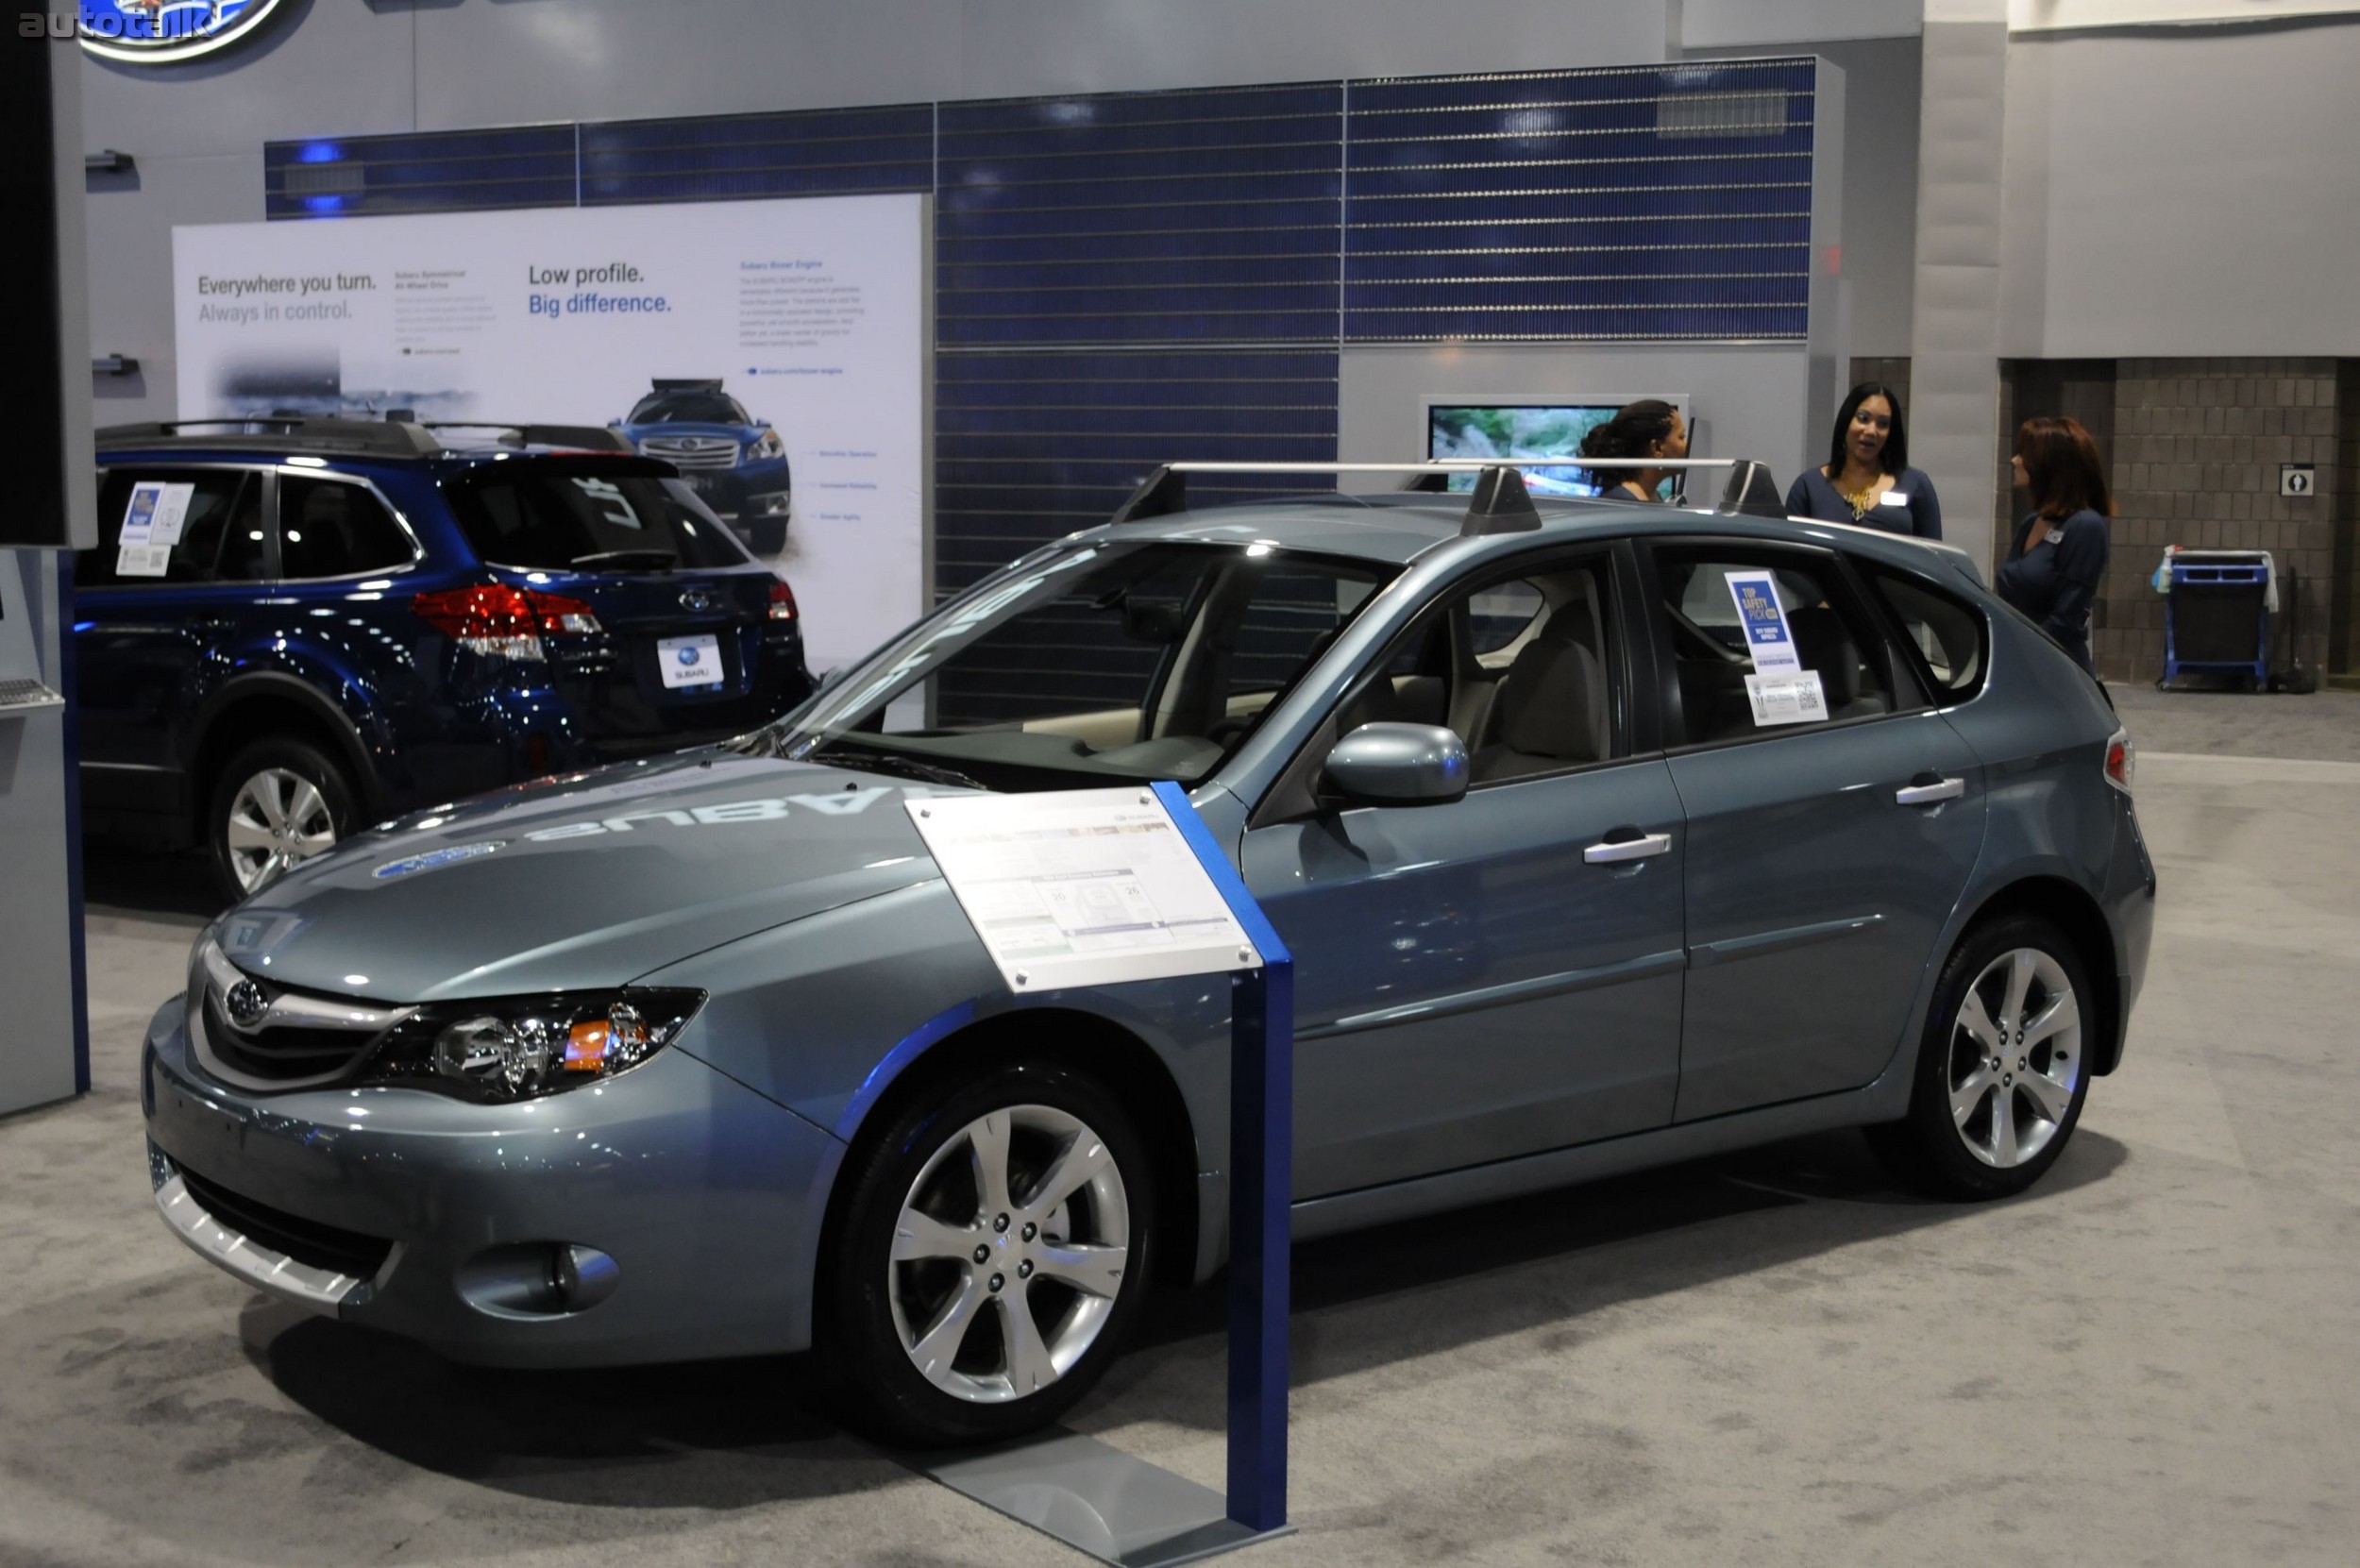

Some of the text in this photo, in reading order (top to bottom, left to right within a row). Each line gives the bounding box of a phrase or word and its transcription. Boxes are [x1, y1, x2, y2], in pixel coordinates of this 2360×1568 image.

[198, 273, 378, 298] Everywhere you turn.
[529, 262, 645, 288] Low profile.
[198, 300, 354, 327] Always in control.
[529, 293, 672, 319] Big difference.
[1742, 587, 1757, 599] TOP
[1743, 598, 1768, 611] SAFETY
[674, 667, 710, 680] SUBARU
